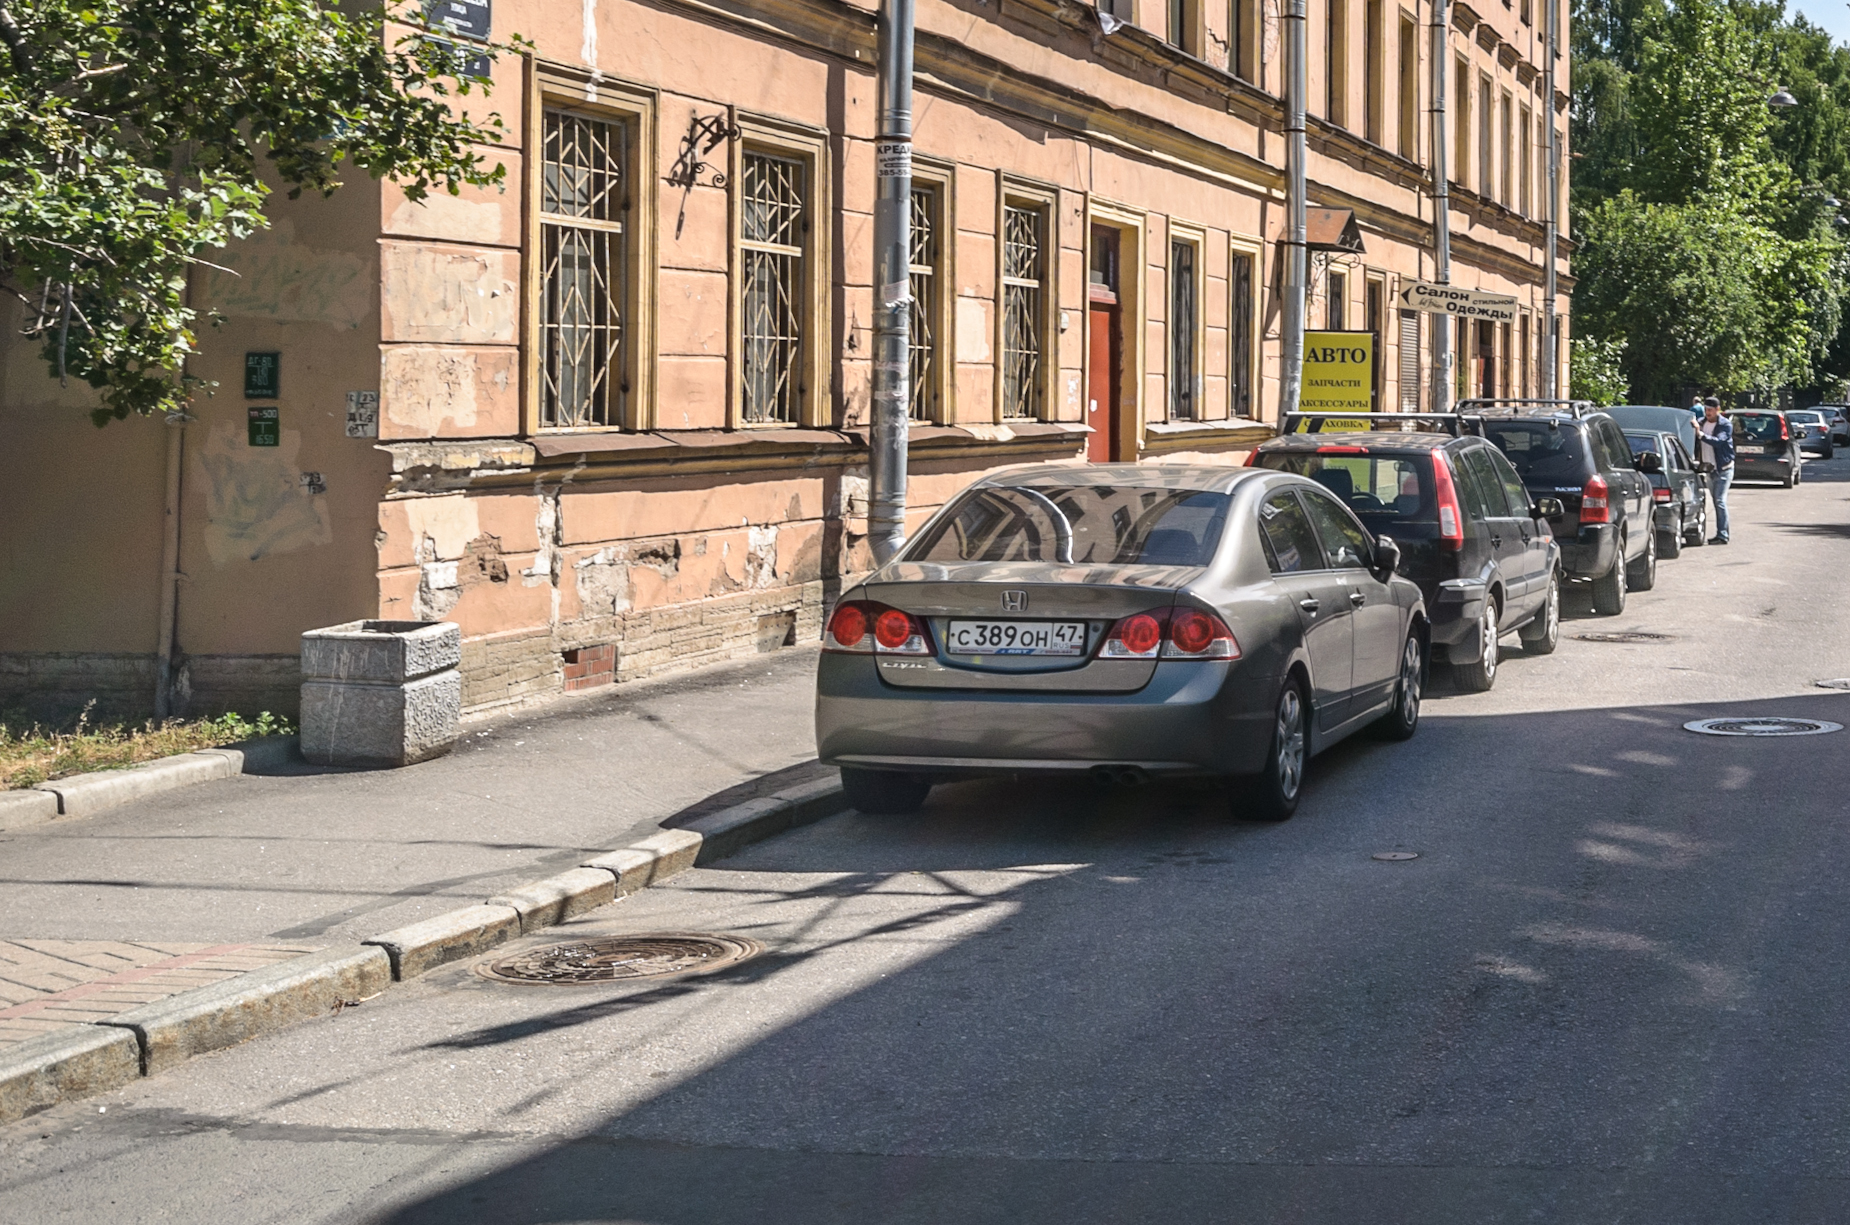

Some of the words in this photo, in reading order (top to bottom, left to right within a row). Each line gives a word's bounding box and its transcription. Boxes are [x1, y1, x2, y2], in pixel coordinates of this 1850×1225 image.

[1415, 285, 1470, 301] Салон
[1472, 297, 1515, 305] стильной
[1446, 301, 1513, 320] Одежды
[1305, 347, 1367, 364] АВТО
[1307, 379, 1361, 387] ЗАПЧАСТИ
[1299, 399, 1369, 408] АКСЕССУАРЫ
[1304, 420, 1364, 428] САХОВКА
[1055, 625, 1078, 642] 47
